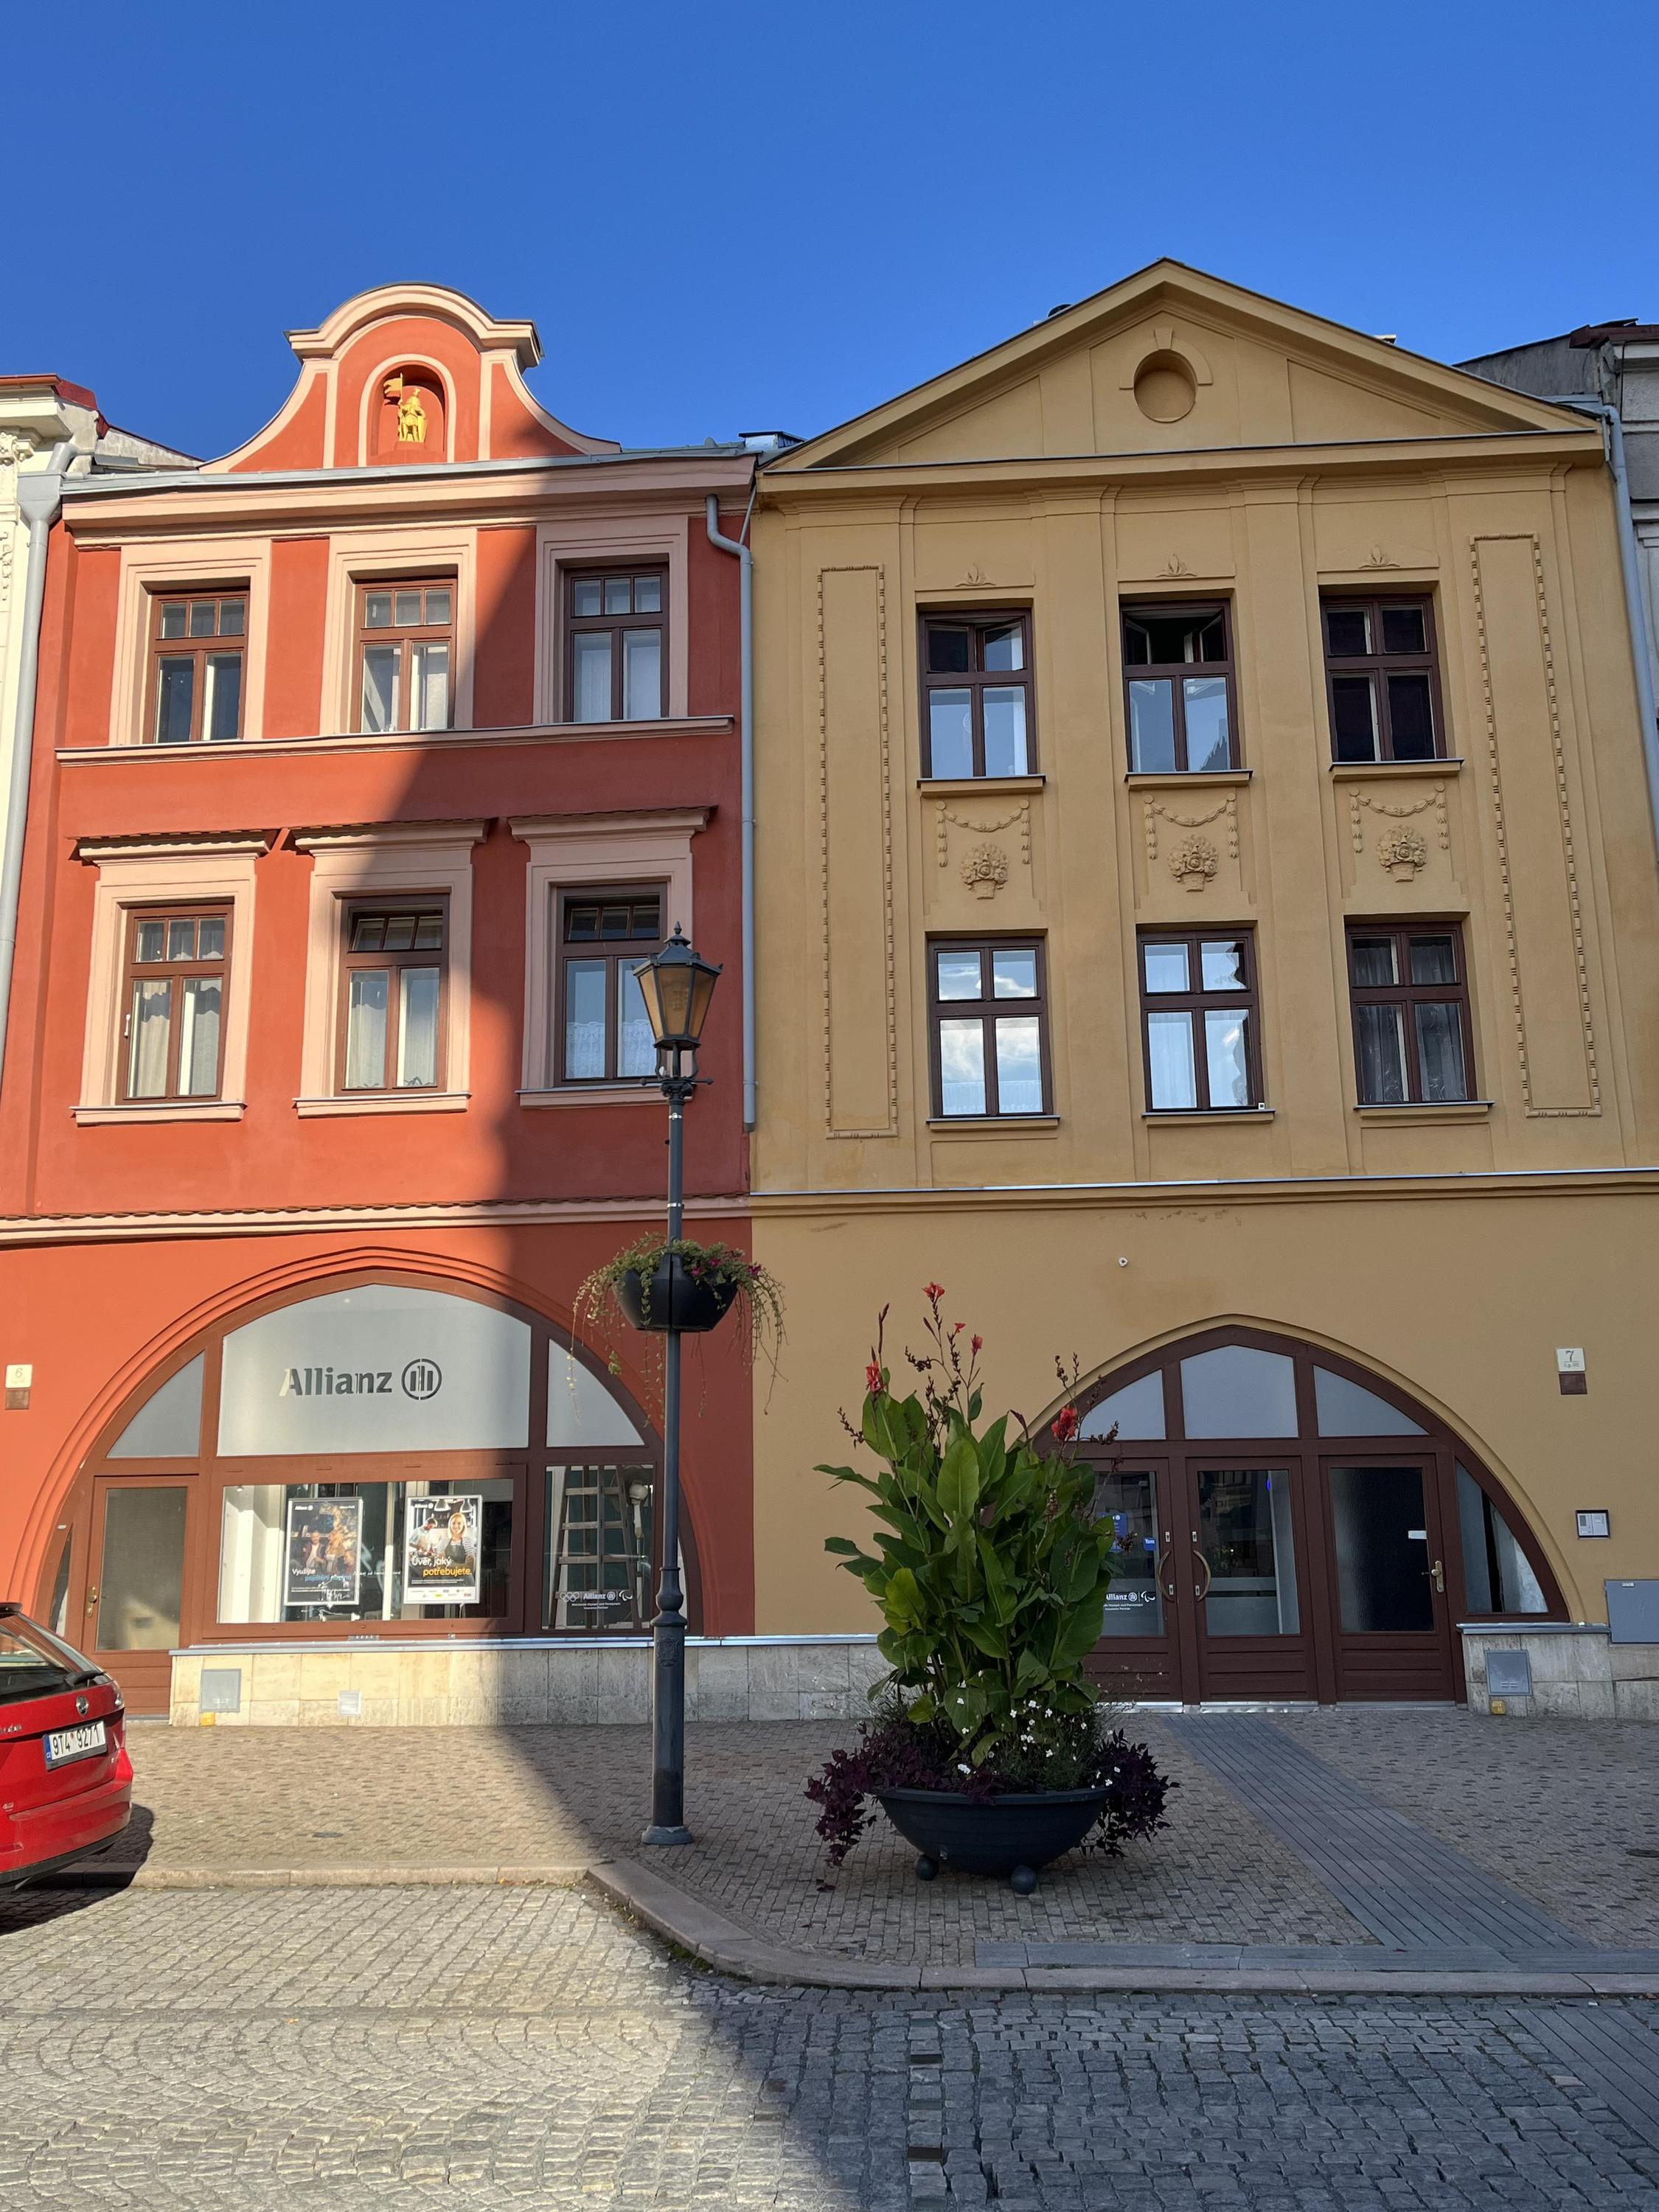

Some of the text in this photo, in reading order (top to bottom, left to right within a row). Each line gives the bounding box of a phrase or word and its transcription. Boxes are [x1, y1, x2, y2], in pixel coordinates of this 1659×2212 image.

[1565, 1350, 1574, 1362] 7
[15, 1367, 24, 1378] 6
[279, 1367, 392, 1397] Allianz
[52, 1725, 100, 1756] 9T4 9271
